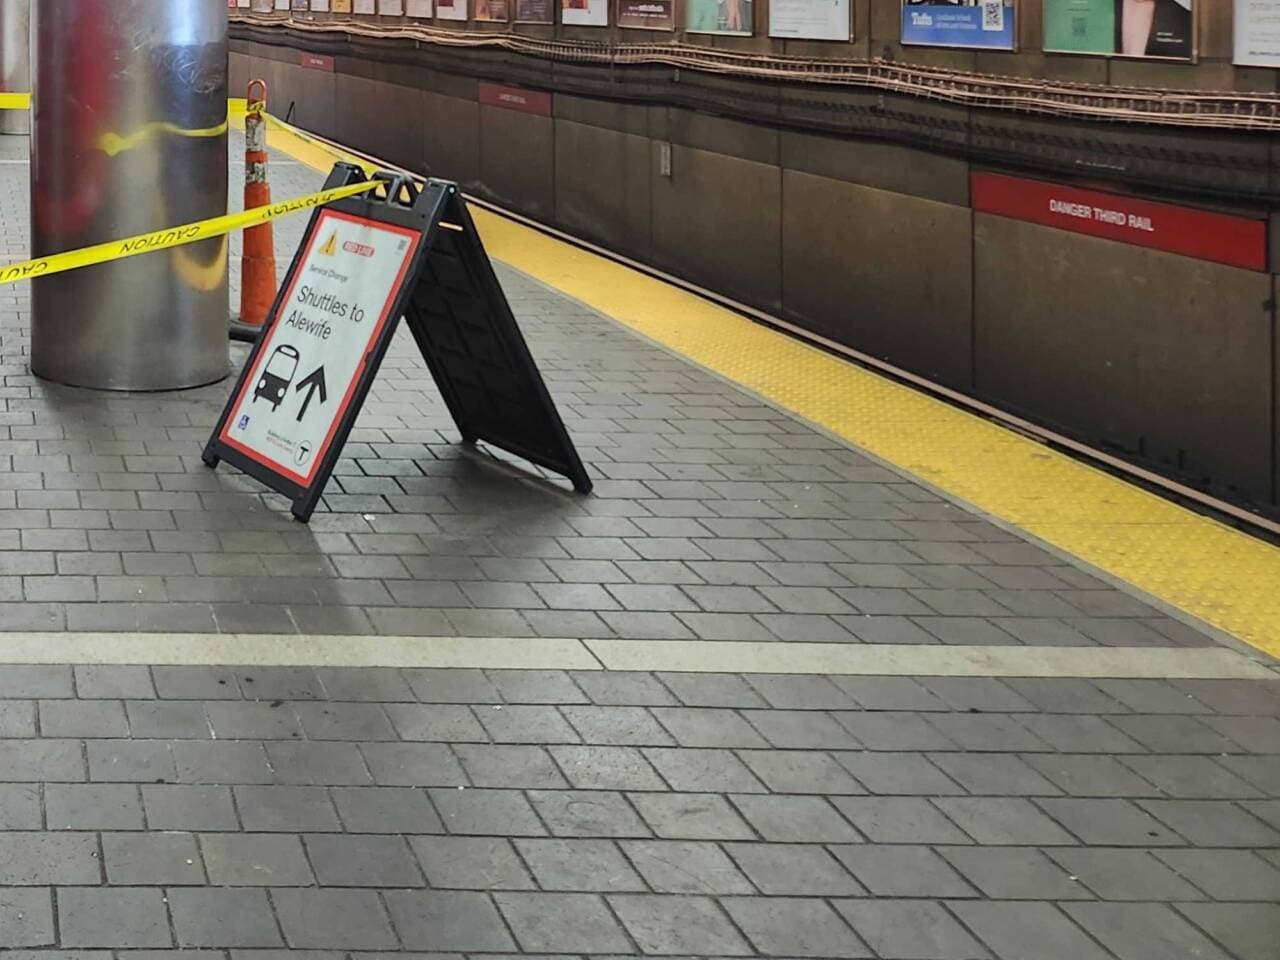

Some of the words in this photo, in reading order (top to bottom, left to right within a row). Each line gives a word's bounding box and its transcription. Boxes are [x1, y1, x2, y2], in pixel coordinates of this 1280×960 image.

[1049, 199, 1092, 219] DANGER
[1093, 207, 1126, 226] THIRD
[1127, 214, 1154, 231] RAIL
[120, 226, 200, 254] CAUTION
[297, 285, 348, 317] Shuttles
[349, 303, 365, 322] to
[285, 309, 331, 340] Alewife
